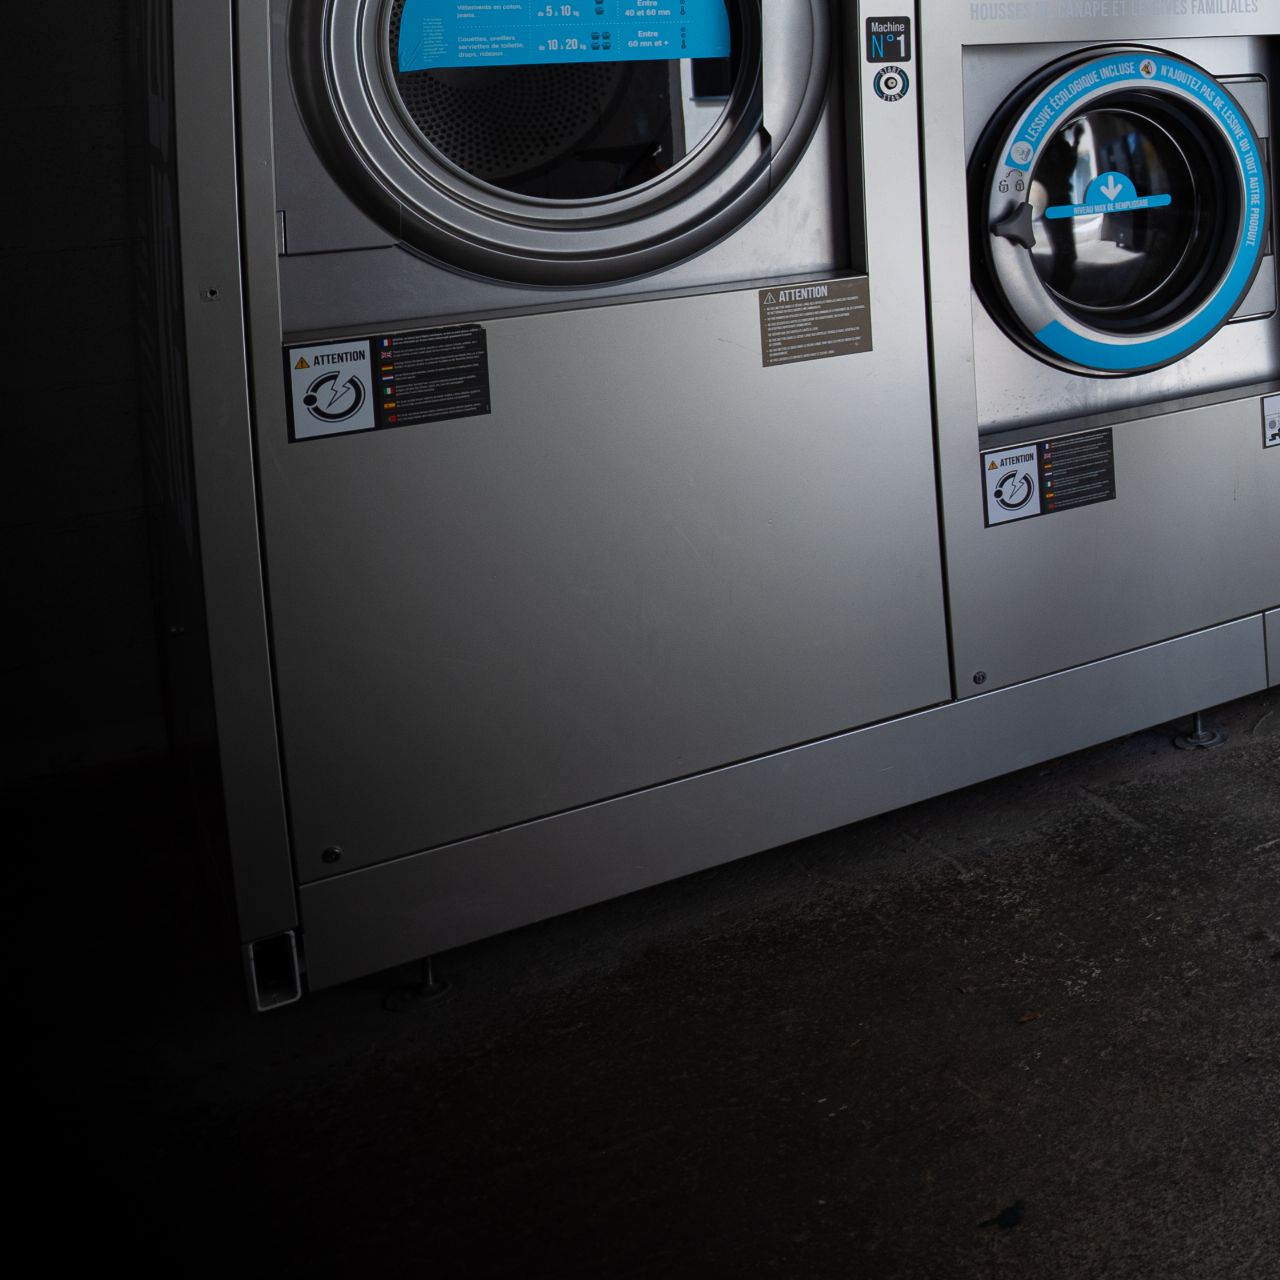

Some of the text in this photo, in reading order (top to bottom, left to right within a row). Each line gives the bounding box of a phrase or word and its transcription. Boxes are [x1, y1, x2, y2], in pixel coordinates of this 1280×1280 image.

[546, 6, 571, 17] 5 10
[1112, 0, 1127, 17] ET
[638, 30, 658, 38] Entre
[872, 22, 905, 32] Machine
[548, 39, 578, 51] 10 20
[1025, 62, 1136, 142] LESSIVE ÉCOLOGIQUE INCLUSE
[1160, 64, 1261, 206] N'AJOUTEZ PAS DE LESSIVE OU TOUT AUTRE
[1074, 204, 1093, 216] NIVEAU
[1094, 203, 1107, 213] MAX
[1108, 202, 1115, 212] DE
[779, 286, 828, 302] ATTENTION
[314, 350, 366, 367] ATTENTION
[1000, 453, 1034, 468] ATTENTION
